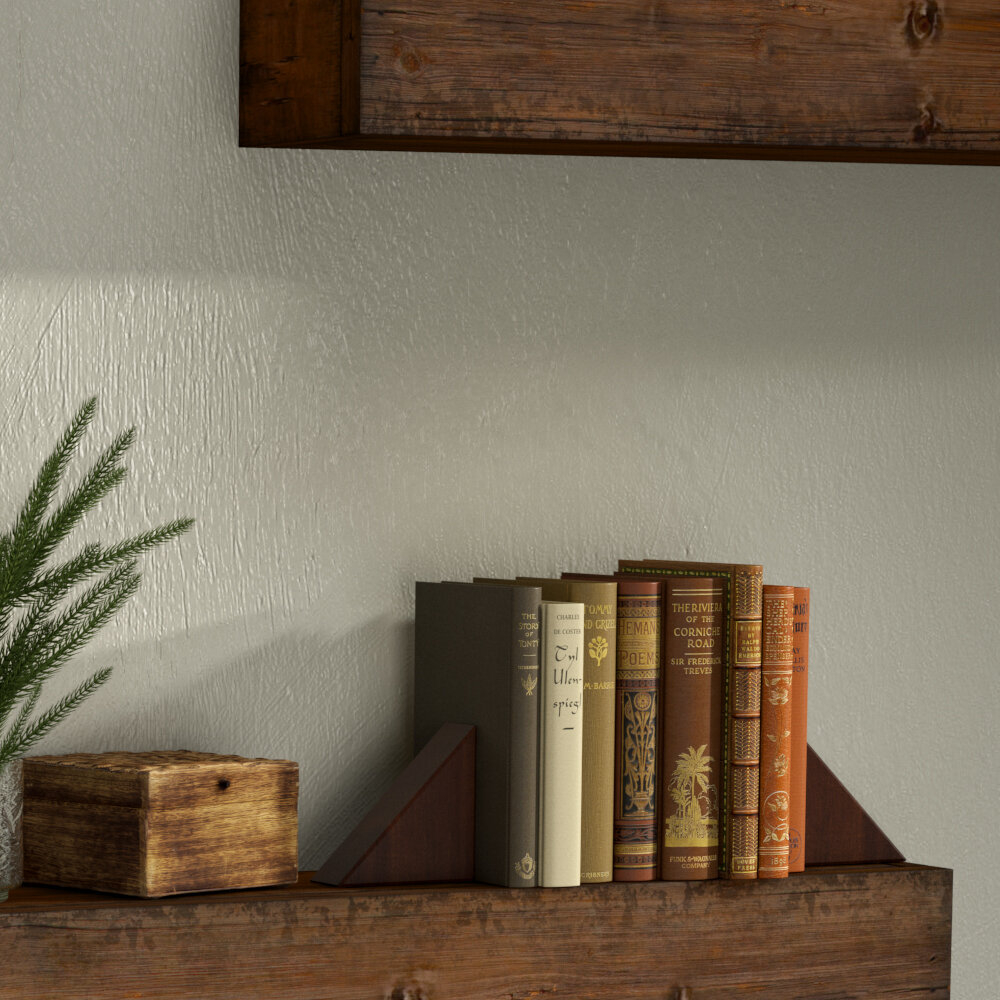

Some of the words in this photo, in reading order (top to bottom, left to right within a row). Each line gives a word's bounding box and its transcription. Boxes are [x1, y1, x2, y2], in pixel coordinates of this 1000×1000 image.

[672, 603, 690, 613] THE
[691, 602, 722, 613] RIVIERA
[685, 615, 698, 623] OF
[701, 615, 715, 623] THE
[618, 619, 660, 636] HEMANS
[673, 626, 721, 637] CORNICHE
[687, 639, 715, 648] ROAD
[618, 649, 660, 668] POEMS
[671, 657, 685, 666] SIR
[683, 667, 713, 675] TREVES
